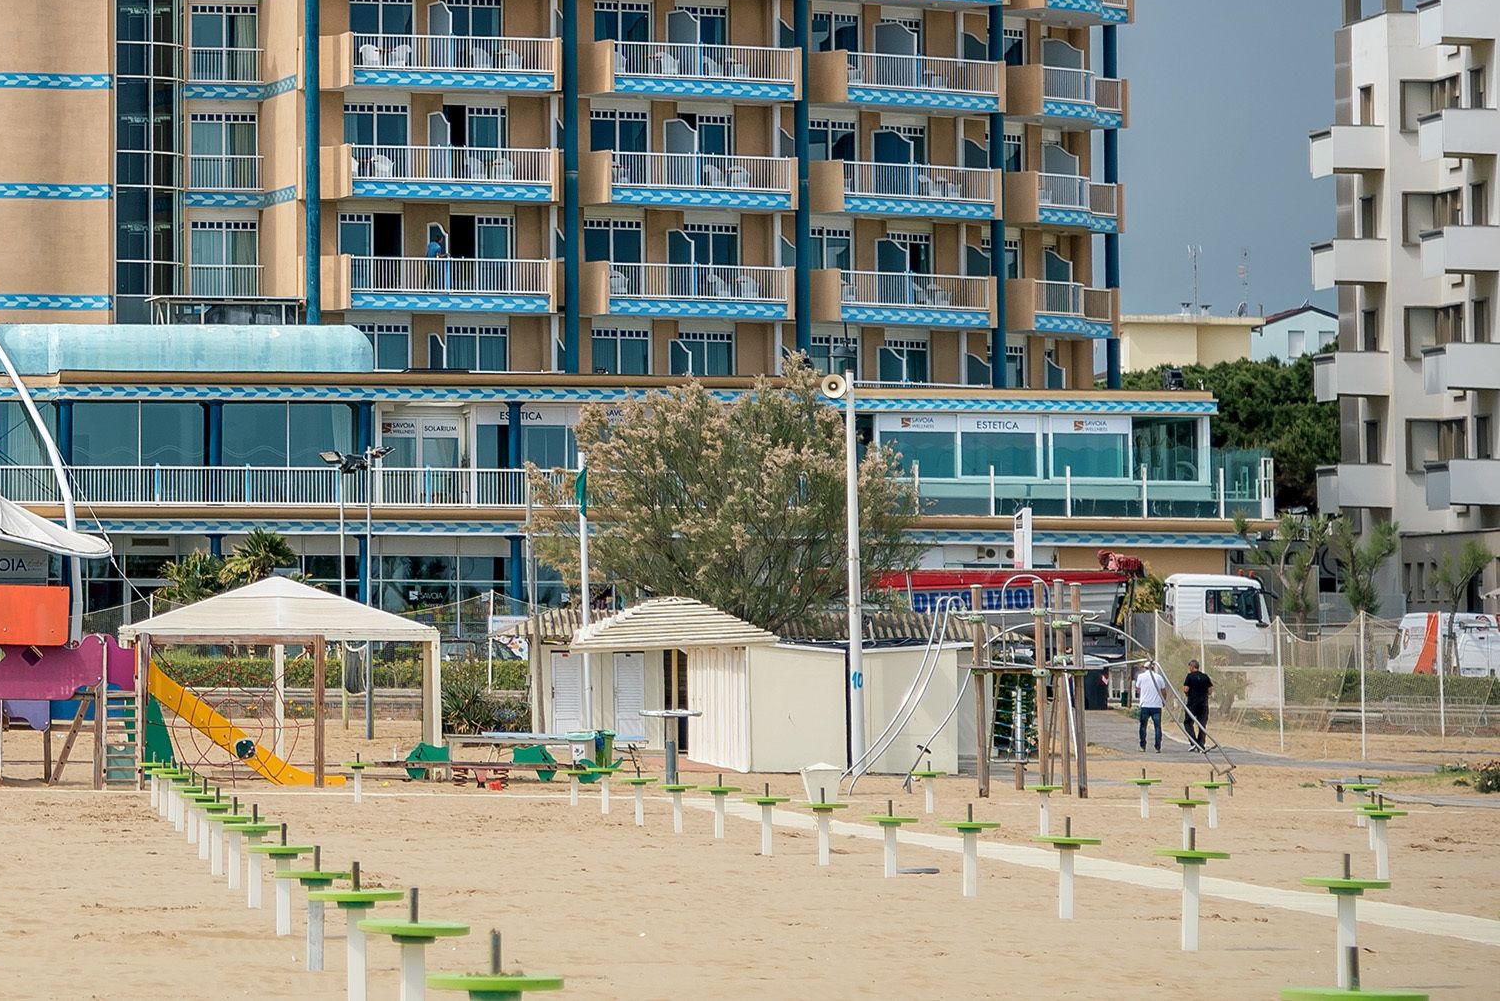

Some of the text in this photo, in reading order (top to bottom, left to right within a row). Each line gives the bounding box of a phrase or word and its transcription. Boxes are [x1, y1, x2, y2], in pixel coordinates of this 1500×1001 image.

[499, 411, 543, 420] ESTICA
[911, 416, 935, 424] SAVOIA
[976, 420, 1020, 430] ESTETICA
[852, 671, 864, 690] 10
